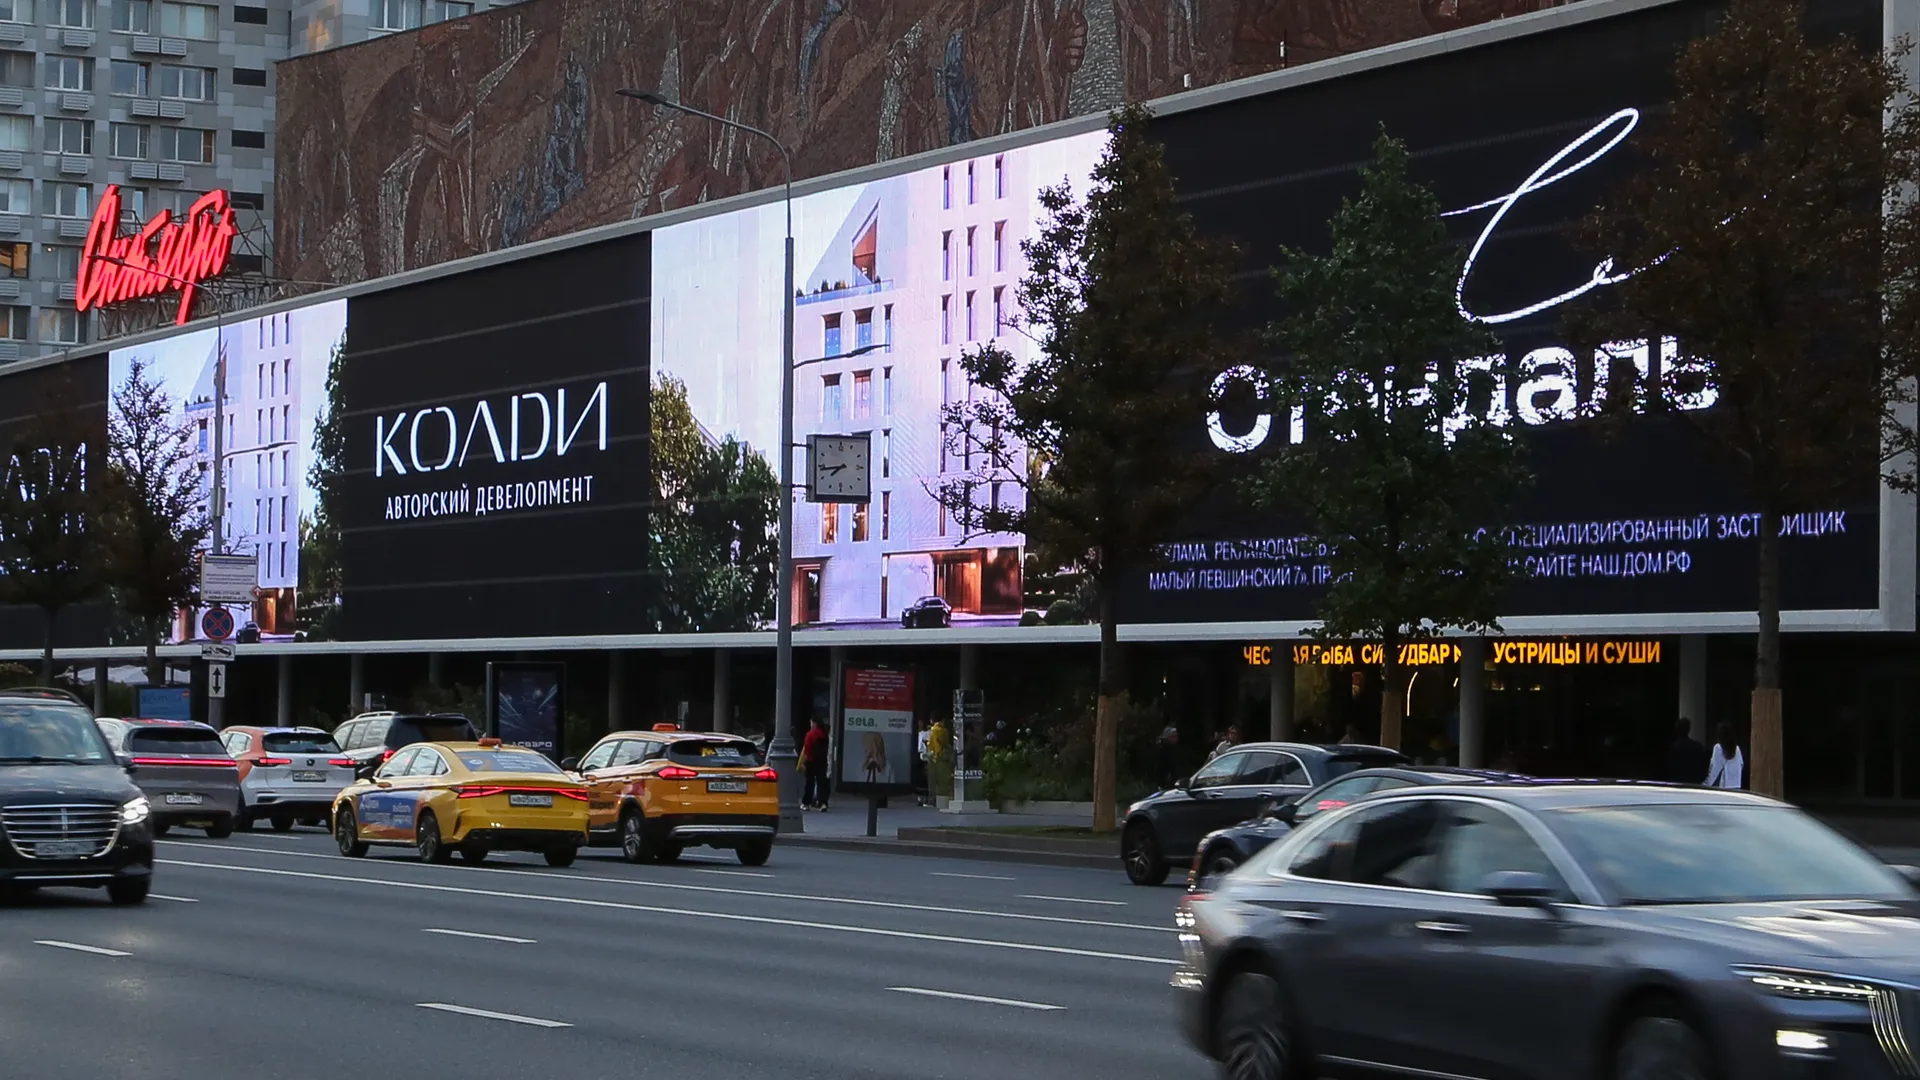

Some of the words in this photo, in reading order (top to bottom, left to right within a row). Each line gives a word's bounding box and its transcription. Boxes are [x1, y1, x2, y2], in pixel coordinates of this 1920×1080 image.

[375, 382, 607, 477] КОЛДИ
[385, 483, 470, 520] АВТОРСКИЙ
[475, 475, 593, 516] ДЕВЕЛОПМЕНТ
[1149, 567, 1195, 590] МАЛЫЙ
[1198, 562, 1291, 589] ЛЕВШИНСКИЙ
[1361, 643, 1449, 666] СИУДБАР
[1493, 642, 1580, 665] УСТРИЦЫ
[1586, 642, 1598, 664] И
[1603, 641, 1661, 664] СУШИ
